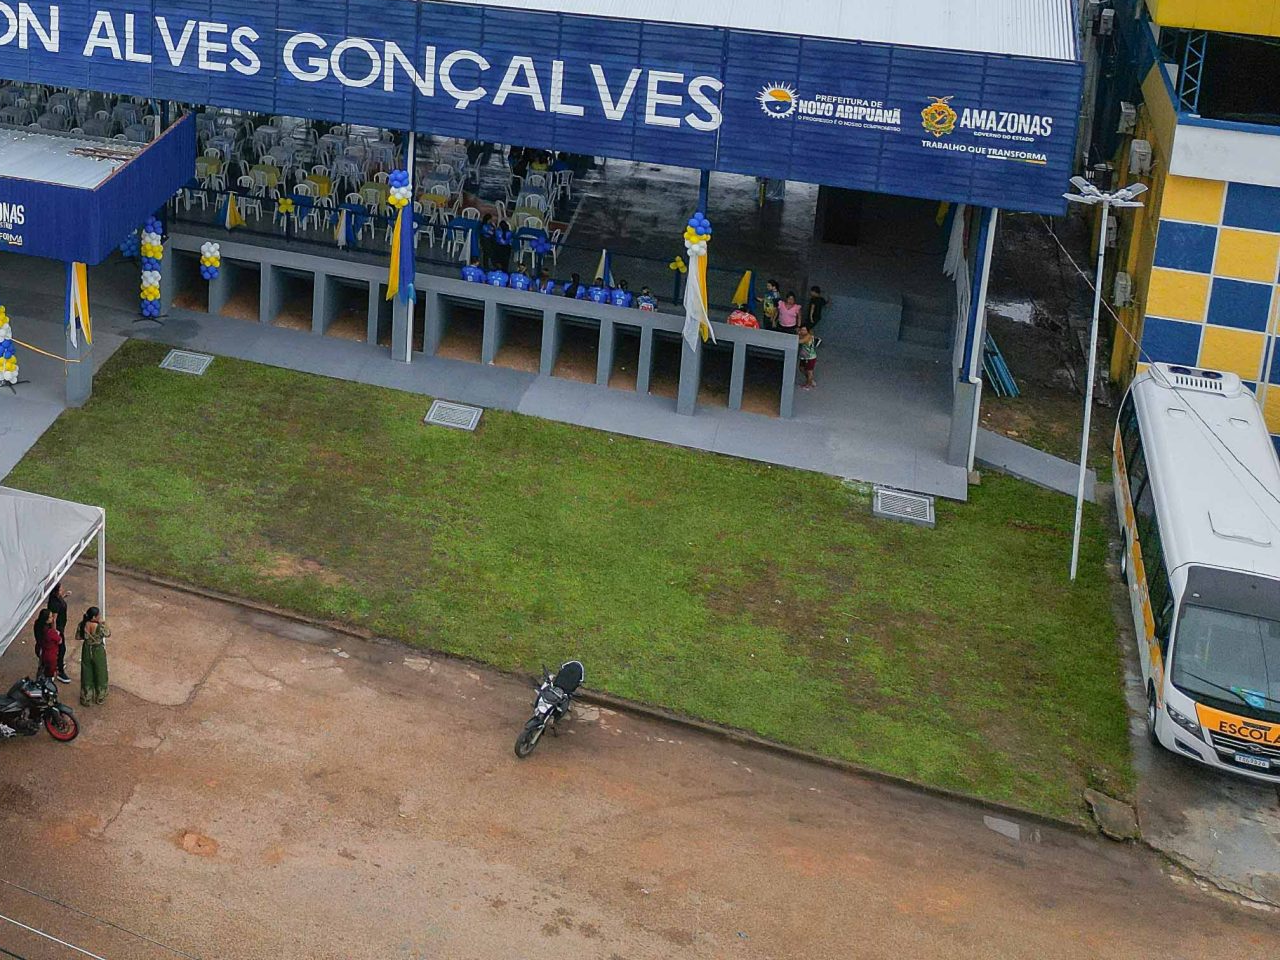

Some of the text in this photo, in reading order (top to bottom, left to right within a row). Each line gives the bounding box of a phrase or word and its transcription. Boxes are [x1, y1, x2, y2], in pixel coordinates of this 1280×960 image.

[82, 10, 261, 76] ALVES
[282, 32, 725, 132] GONÇALVES
[798, 99, 901, 125] NOVO ARIPUANÃ
[815, 94, 884, 108] PREFEITURA DE
[959, 108, 1053, 137] AMAZONAS
[973, 131, 1002, 139] GOVERNO
[1012, 135, 1035, 143] ESTADO
[921, 139, 1047, 161] TRABALHO QUE TRANSFORMA
